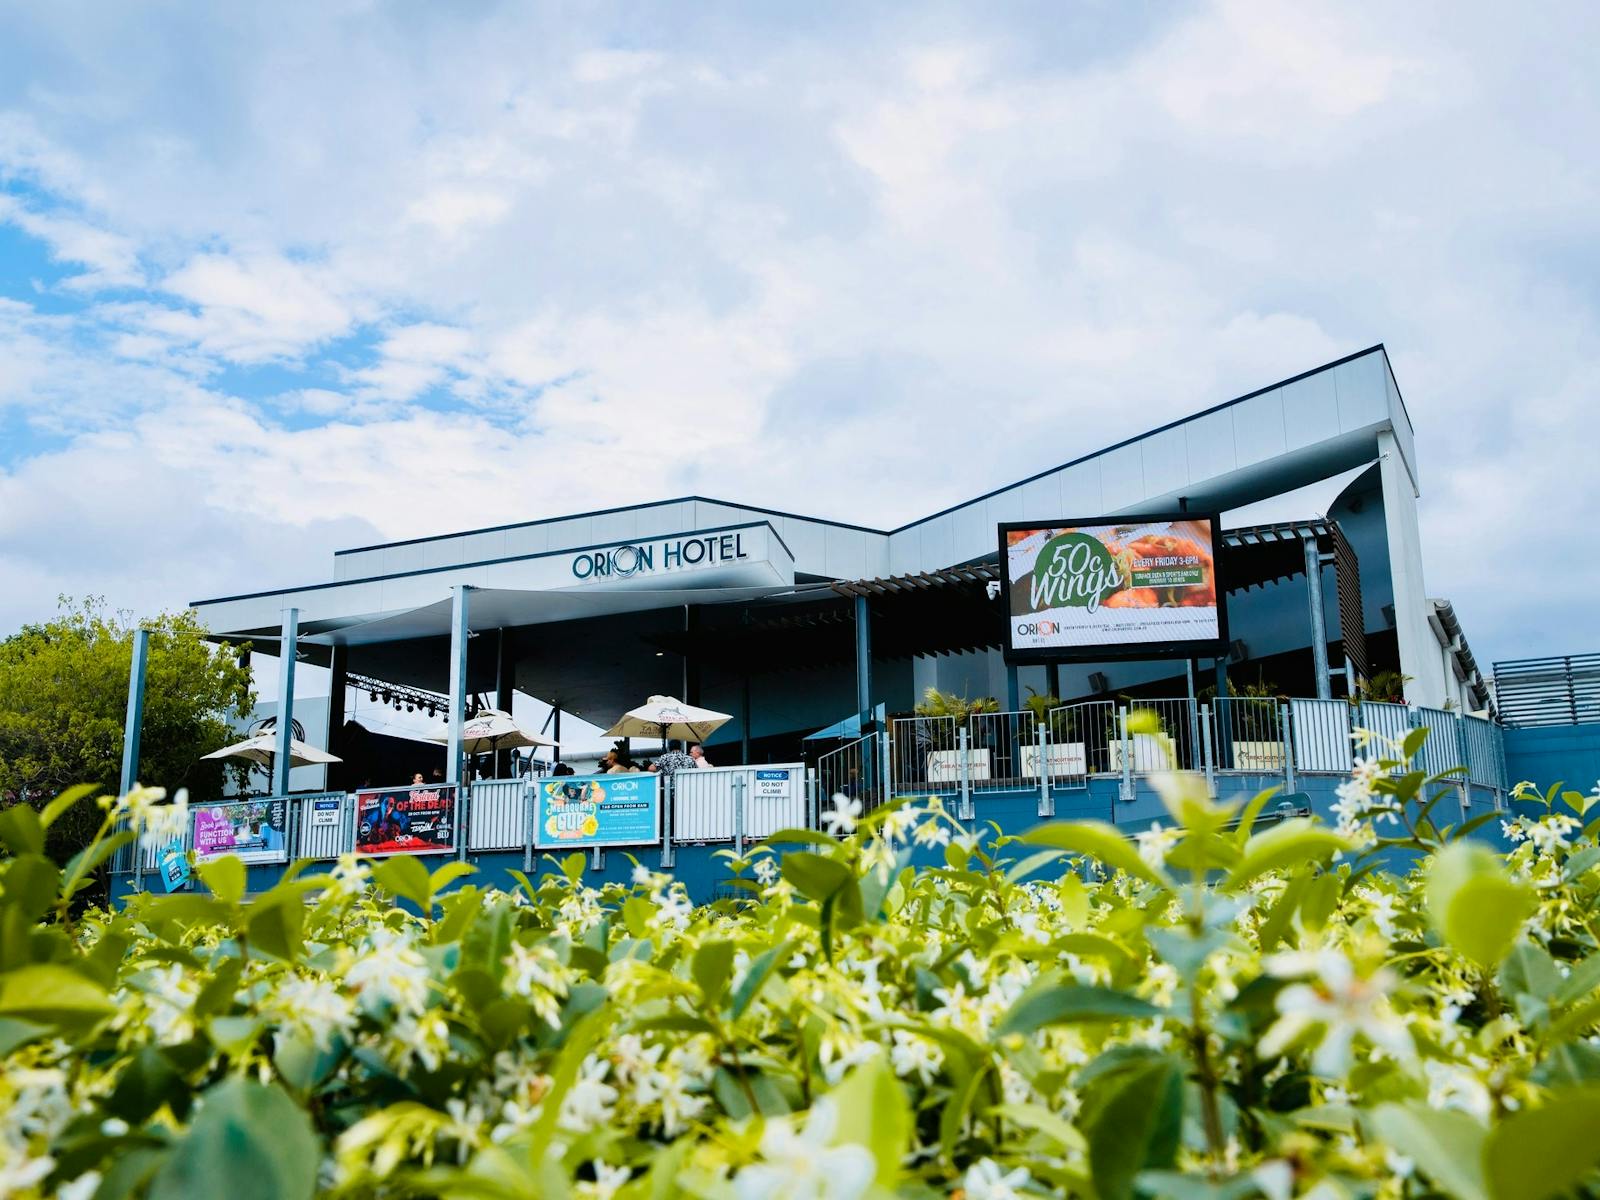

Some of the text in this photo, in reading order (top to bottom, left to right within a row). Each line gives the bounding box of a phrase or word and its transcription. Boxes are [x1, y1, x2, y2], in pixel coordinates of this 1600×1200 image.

[572, 533, 747, 579] ORION HOTEL
[1048, 542, 1104, 577] 50c
[1133, 557, 1154, 568] EVERY
[1155, 556, 1178, 567] FRIDAY
[1017, 620, 1060, 636] ORION
[611, 781, 639, 792] ORION
[396, 801, 408, 811] OF
[410, 800, 426, 811] THE
[200, 821, 214, 831] Book
[200, 829, 234, 839] FUNCTION
[218, 836, 227, 844] US
